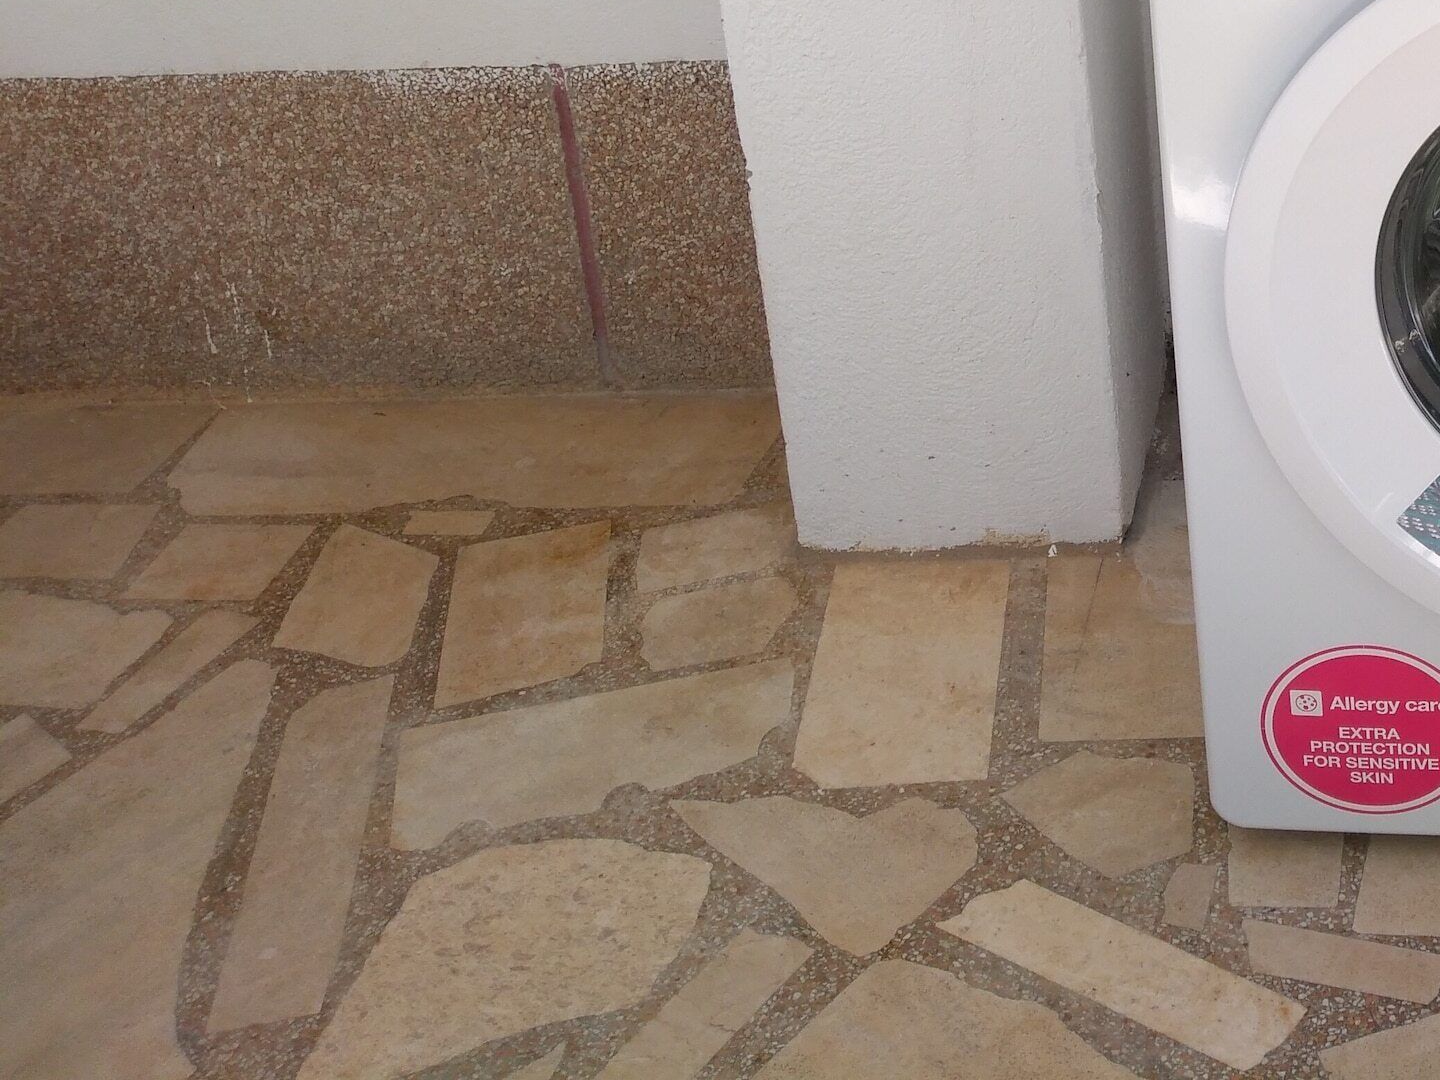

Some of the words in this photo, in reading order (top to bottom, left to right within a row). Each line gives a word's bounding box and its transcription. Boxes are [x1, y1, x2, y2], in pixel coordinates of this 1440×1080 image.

[1330, 695, 1400, 714] Allergy
[1338, 727, 1400, 740] EXTRA
[1310, 741, 1430, 755] PROTECTION
[1303, 755, 1341, 768] FOR
[1346, 757, 1439, 771] SENSITIVE
[1350, 771, 1394, 784] SKIN
